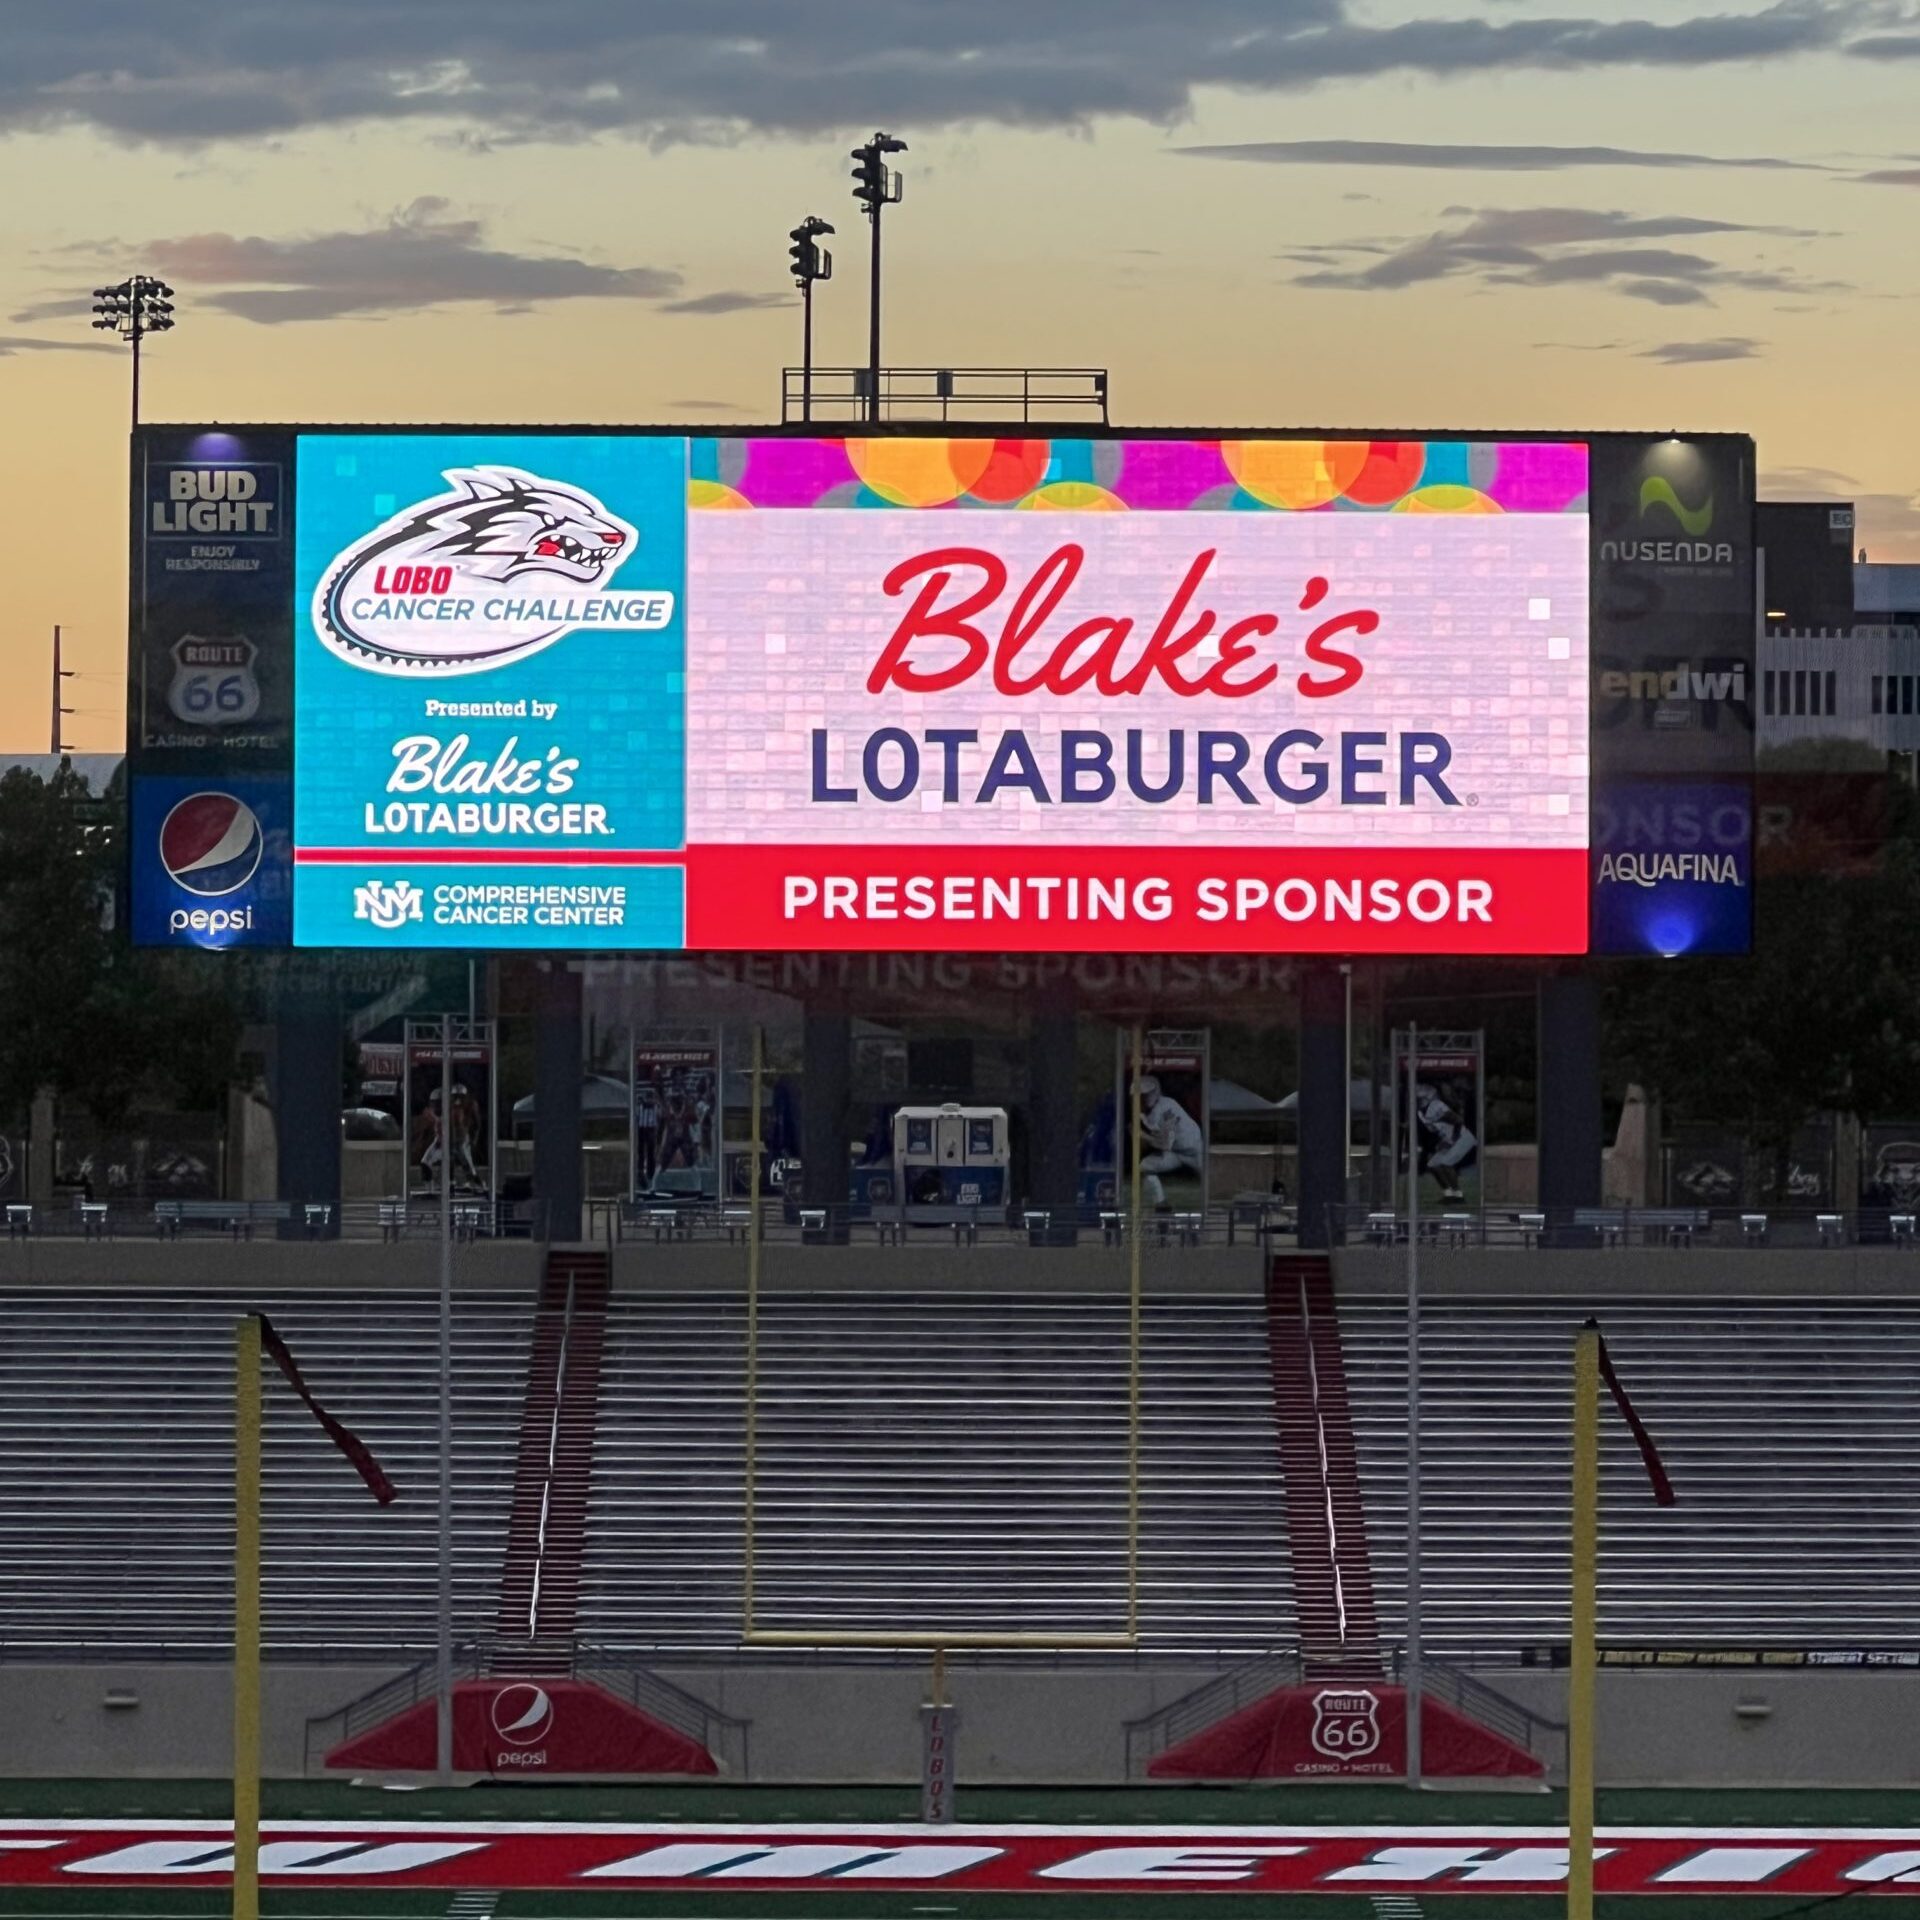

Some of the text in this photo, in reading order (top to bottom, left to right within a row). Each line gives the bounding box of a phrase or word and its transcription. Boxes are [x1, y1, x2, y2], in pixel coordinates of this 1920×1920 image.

[170, 470, 257, 501] BUD
[153, 501, 274, 532] LIGHT
[191, 545, 236, 557] ENJOY
[1600, 541, 1733, 563] NUSENDA
[374, 566, 453, 595] LOBO
[351, 598, 666, 622] CANCER CHALLENGE
[866, 543, 1380, 698] Blake's
[185, 646, 244, 663] ROUTE
[182, 675, 245, 712] 66
[1600, 662, 1746, 700] endwi
[425, 700, 558, 720] Presented by
[143, 735, 279, 748] CASINO HOTEL
[386, 733, 580, 794] Blake's
[811, 726, 1465, 808] LOTABURGER
[365, 802, 611, 834] LOTABURGER
[1598, 853, 1742, 887] AQUAFINA
[433, 885, 627, 905] COMPREHENSIVE
[784, 876, 1493, 924] PRESENTING SPONSOR
[170, 905, 252, 935] pepsi
[433, 906, 625, 926] CANCER CENTER
[1325, 1698, 1367, 1711] ROUTE
[1323, 1720, 1369, 1746] 66
[497, 1749, 547, 1767] pepsi
[1294, 1763, 1394, 1774] CASINO HOTEL
